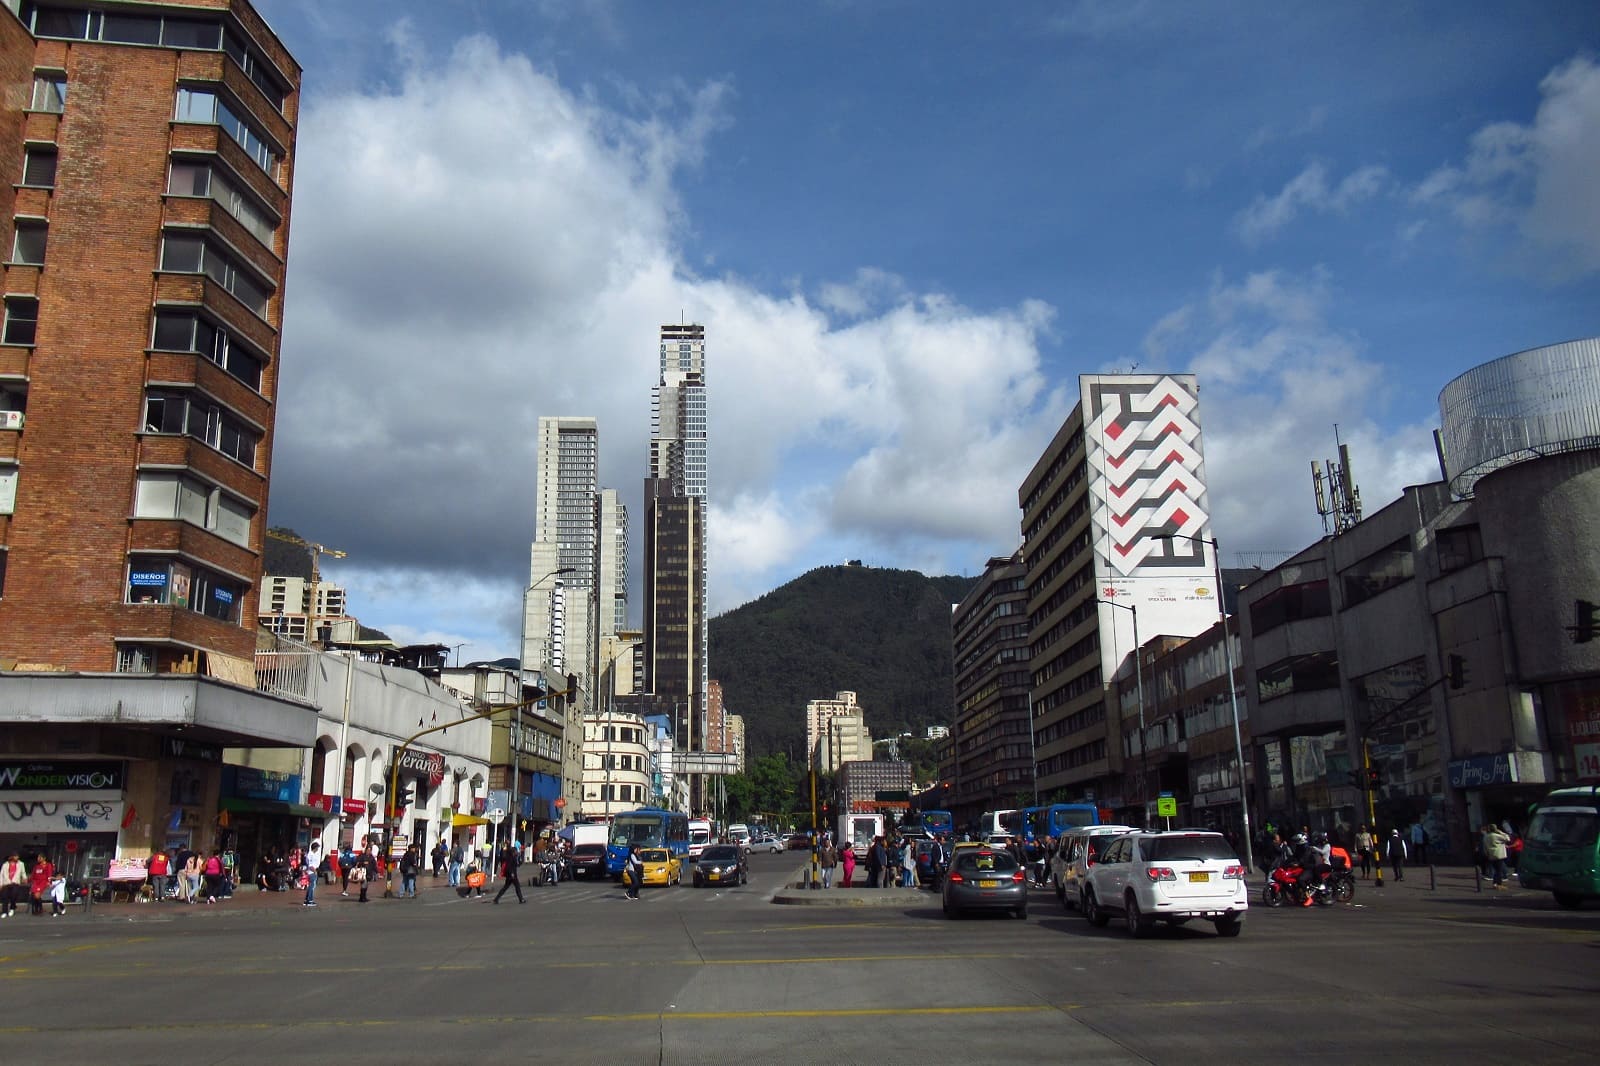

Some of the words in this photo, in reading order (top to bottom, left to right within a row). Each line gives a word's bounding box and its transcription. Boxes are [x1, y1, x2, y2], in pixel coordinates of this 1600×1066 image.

[133, 572, 166, 580] DISEÑOS
[397, 750, 438, 773] Verano
[0, 767, 114, 788] WONDERVISION
